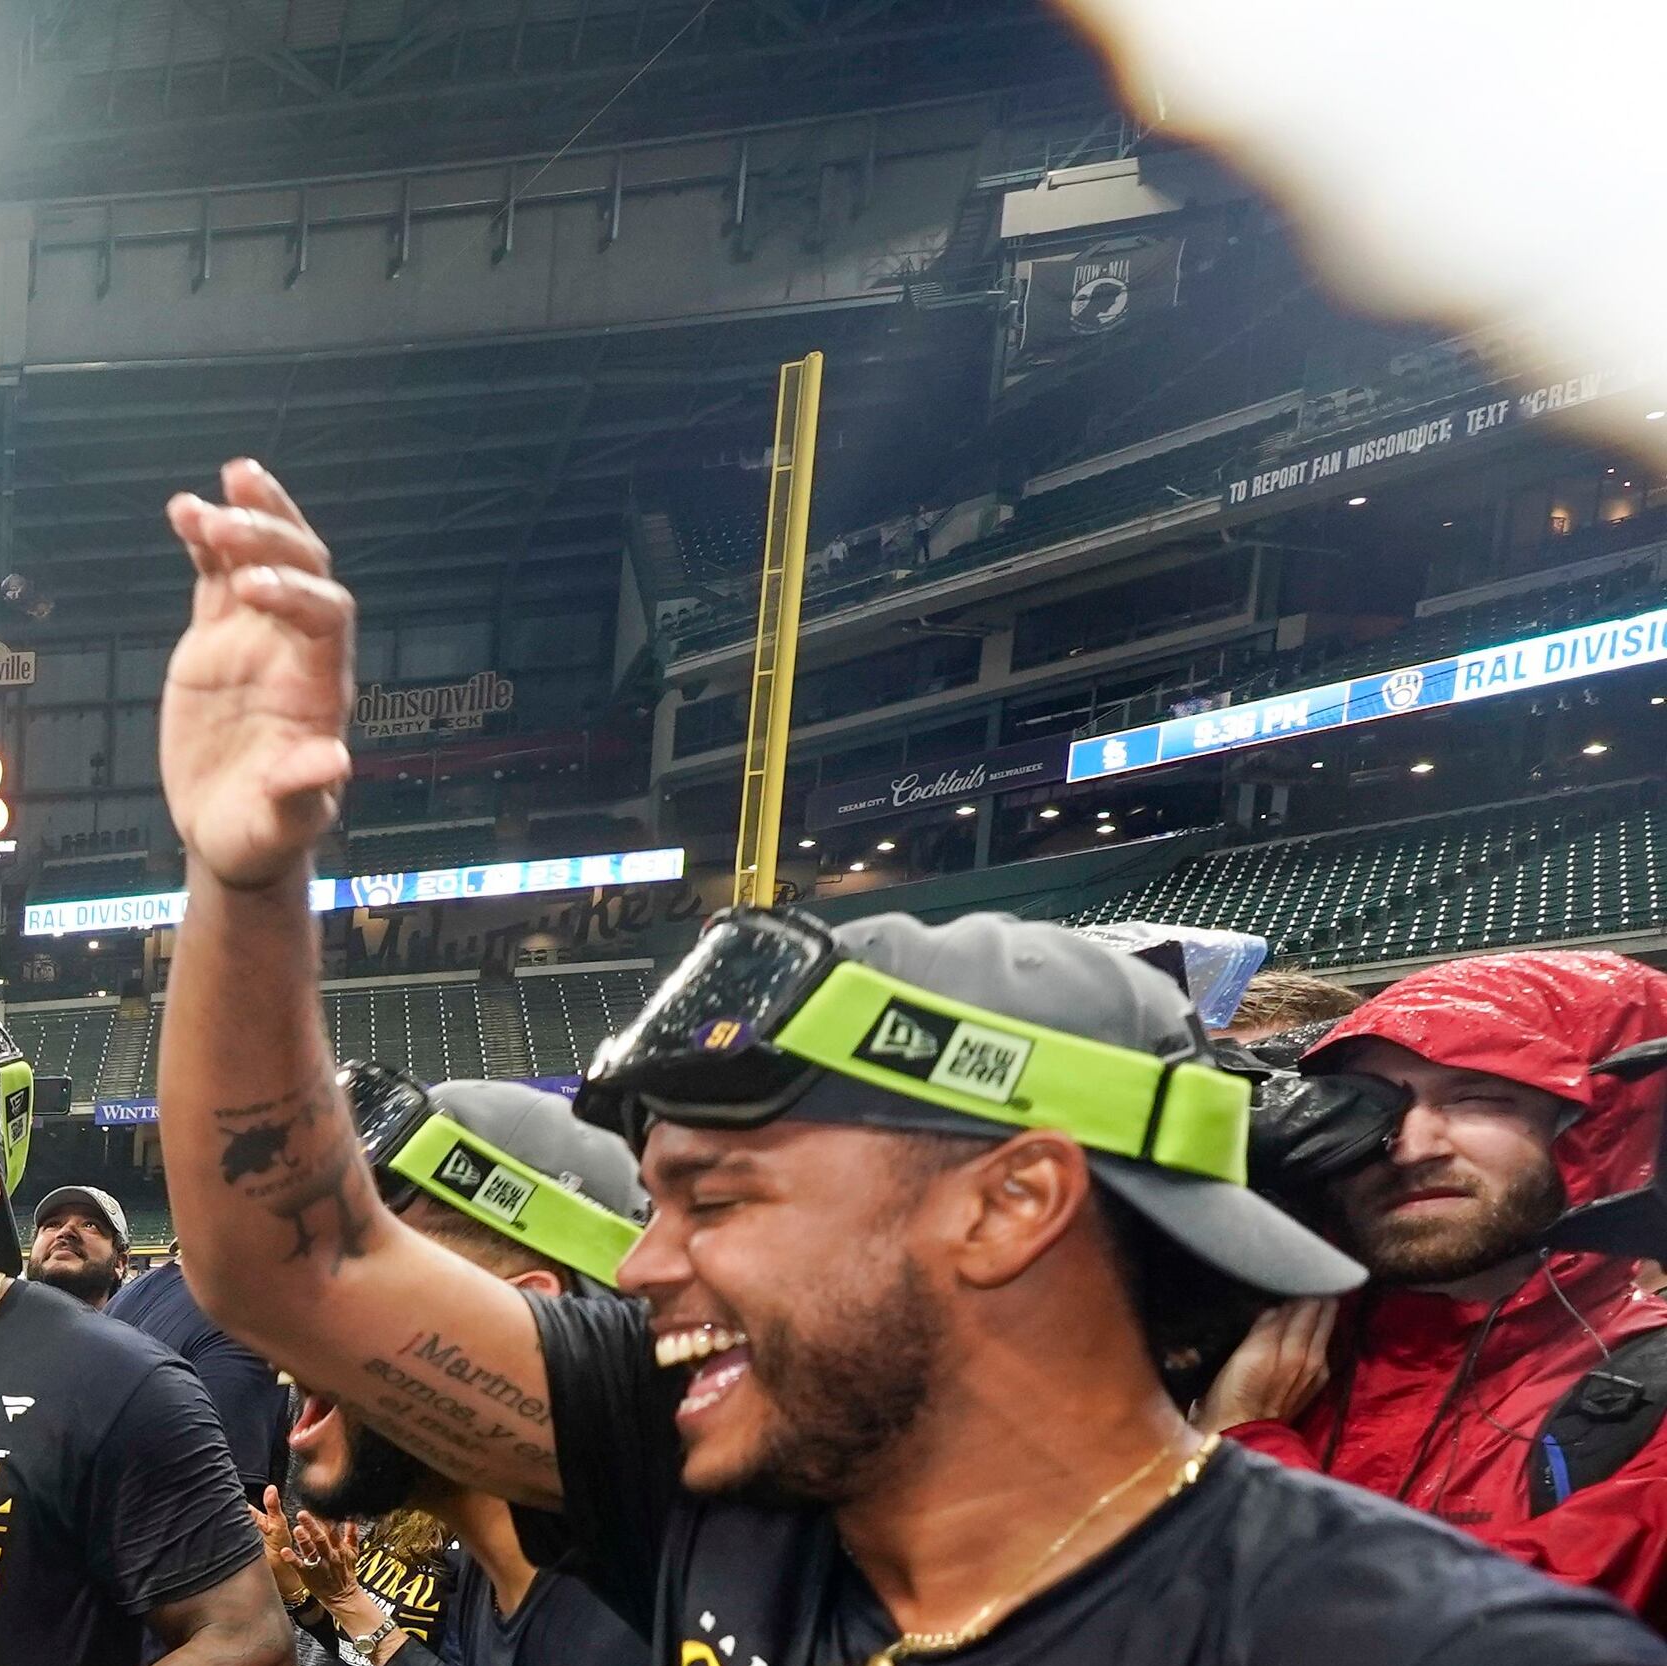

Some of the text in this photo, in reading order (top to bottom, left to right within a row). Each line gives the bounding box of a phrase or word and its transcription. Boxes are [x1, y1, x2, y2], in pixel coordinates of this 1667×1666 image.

[1230, 482, 1246, 504] TO
[1252, 461, 1308, 499] REPORT
[1312, 450, 1341, 481] FAN
[1466, 399, 1509, 435] TEXT
[367, 719, 423, 738] PARTY
[1194, 696, 1309, 749] 9:36 PM
[891, 763, 987, 807] Cocktails
[989, 762, 1044, 781] MILWAUKEE
[77, 896, 171, 928] DIVISION
[961, 1036, 1017, 1067] NEW
[948, 1053, 1009, 1087] ERA
[102, 1105, 160, 1122] WINTR
[483, 1186, 519, 1215] ERA
[491, 1174, 526, 1202] NEW
[356, 1542, 441, 1613] NTRAL
